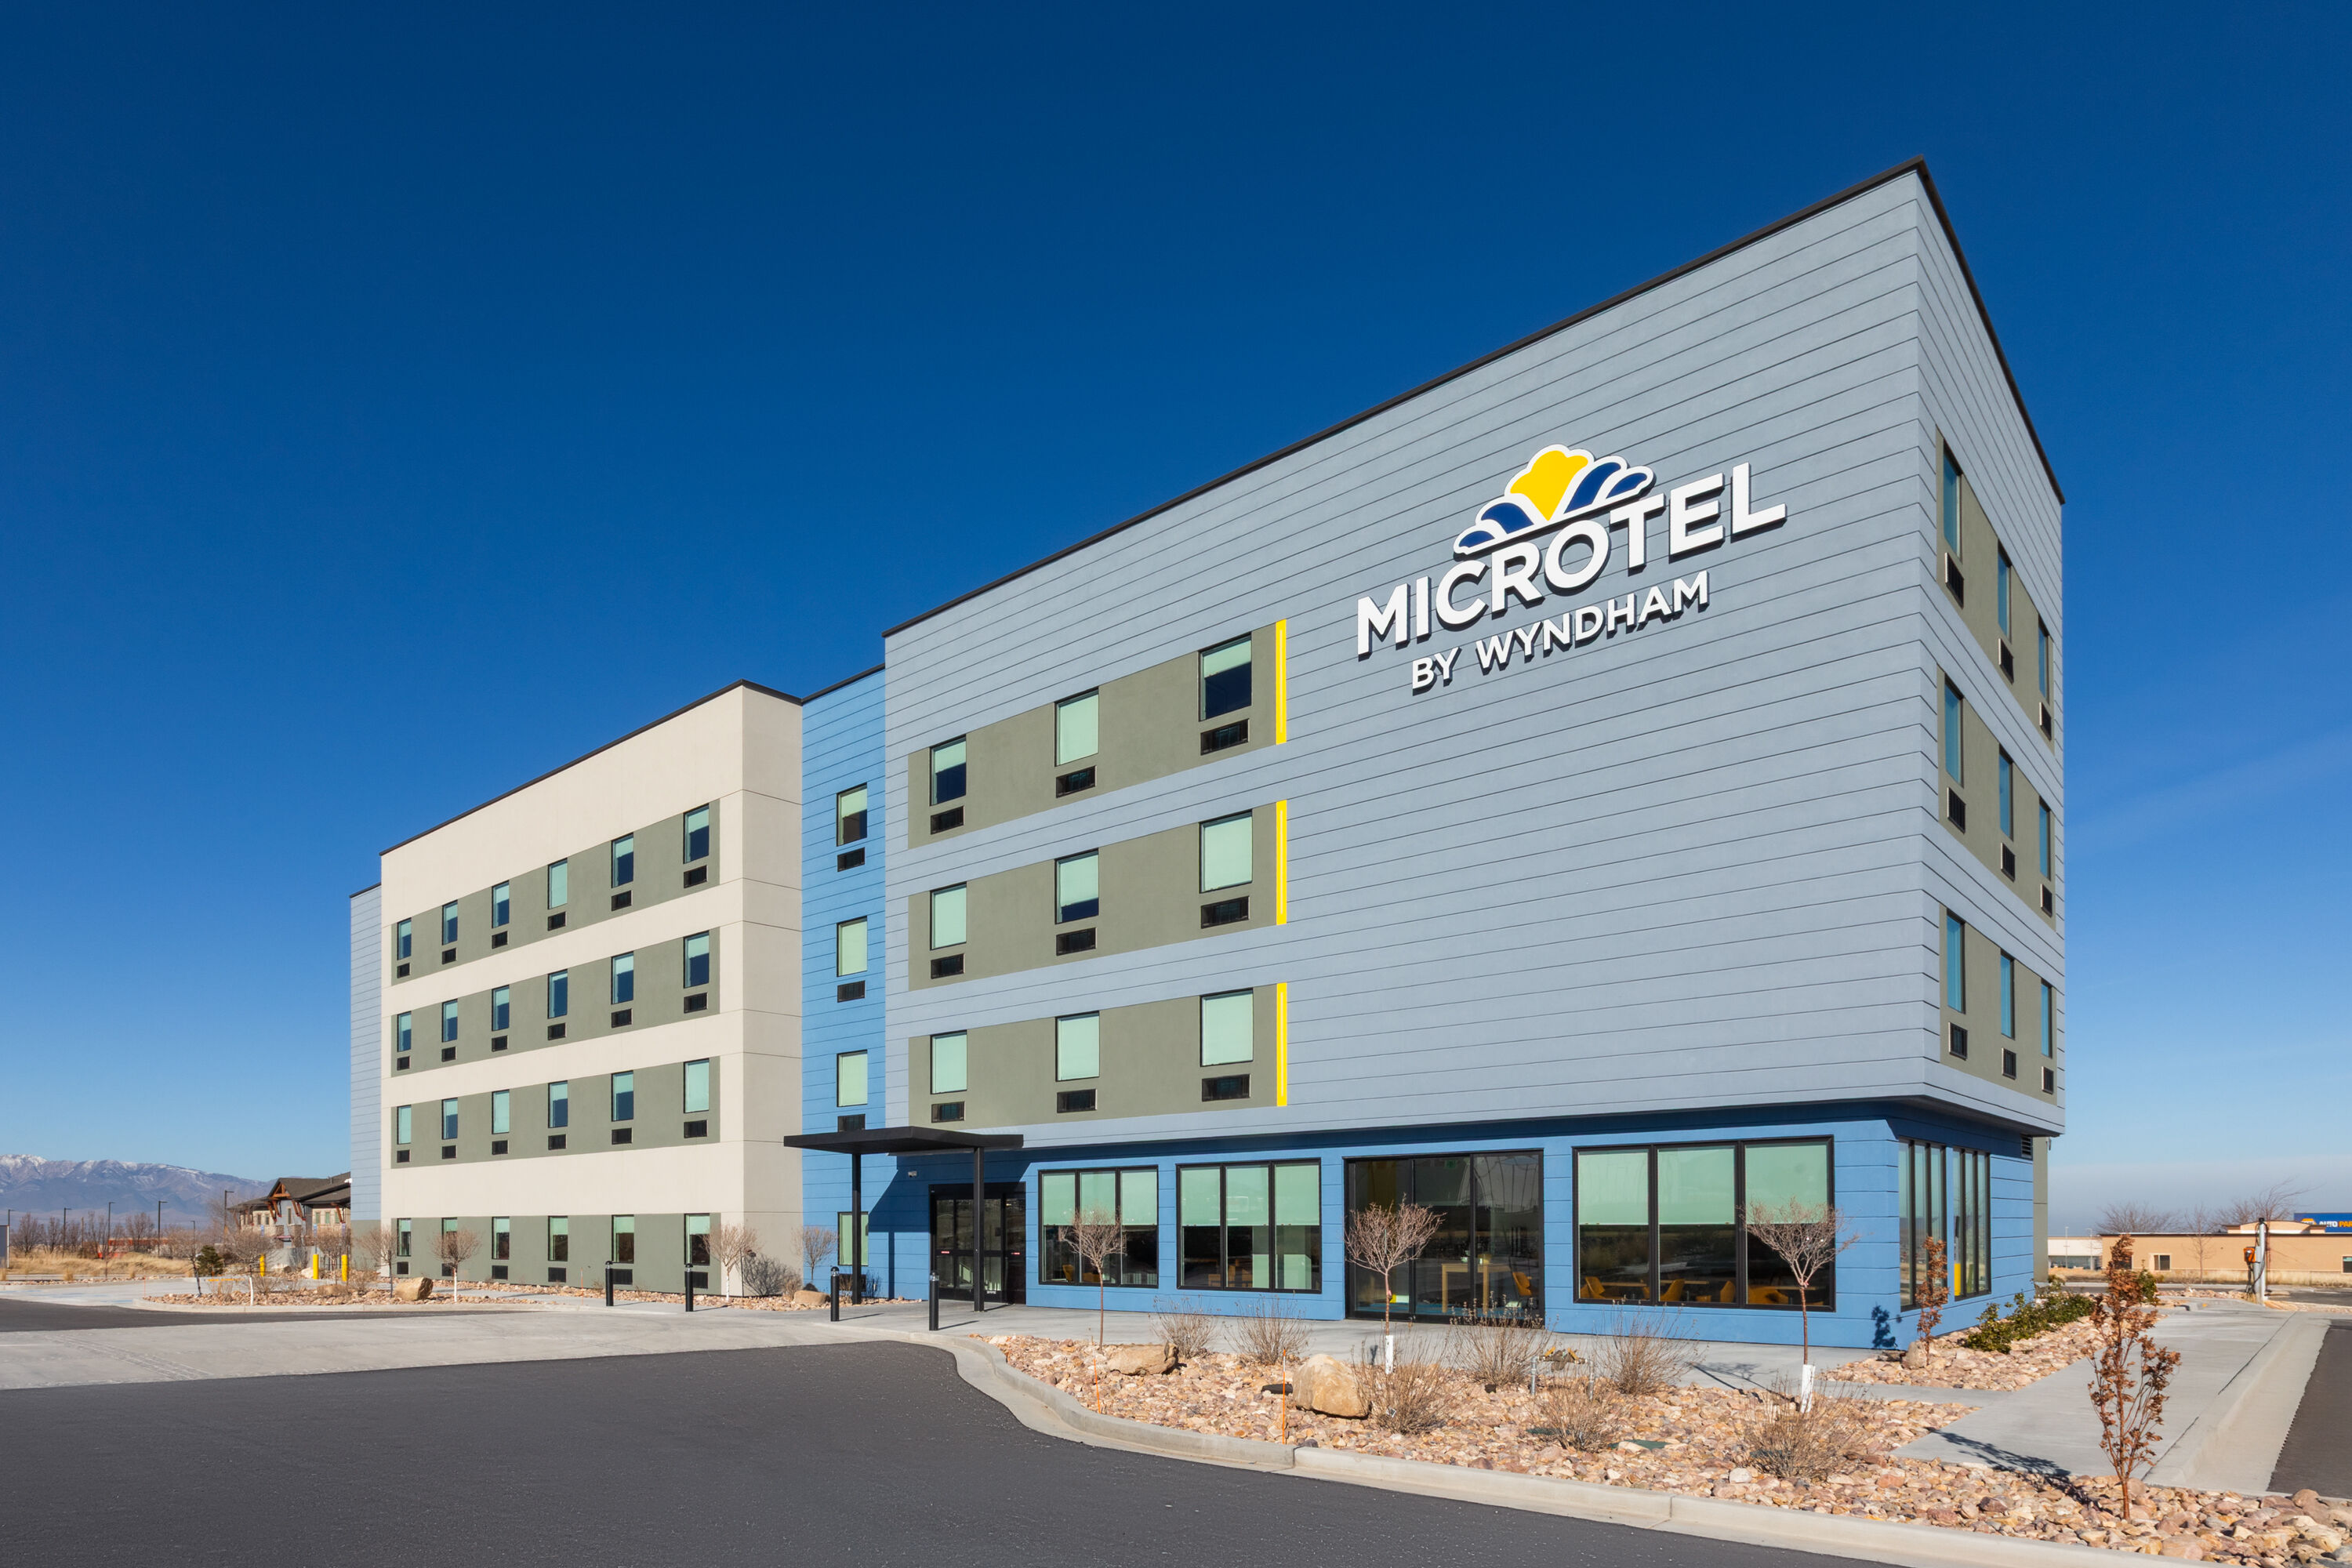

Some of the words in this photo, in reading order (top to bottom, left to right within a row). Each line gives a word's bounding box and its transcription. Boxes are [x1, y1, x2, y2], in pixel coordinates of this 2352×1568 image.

[1357, 462, 1787, 656] MICROTEL
[1412, 647, 1461, 691] BY
[1475, 570, 1709, 670] WYNDHAM
